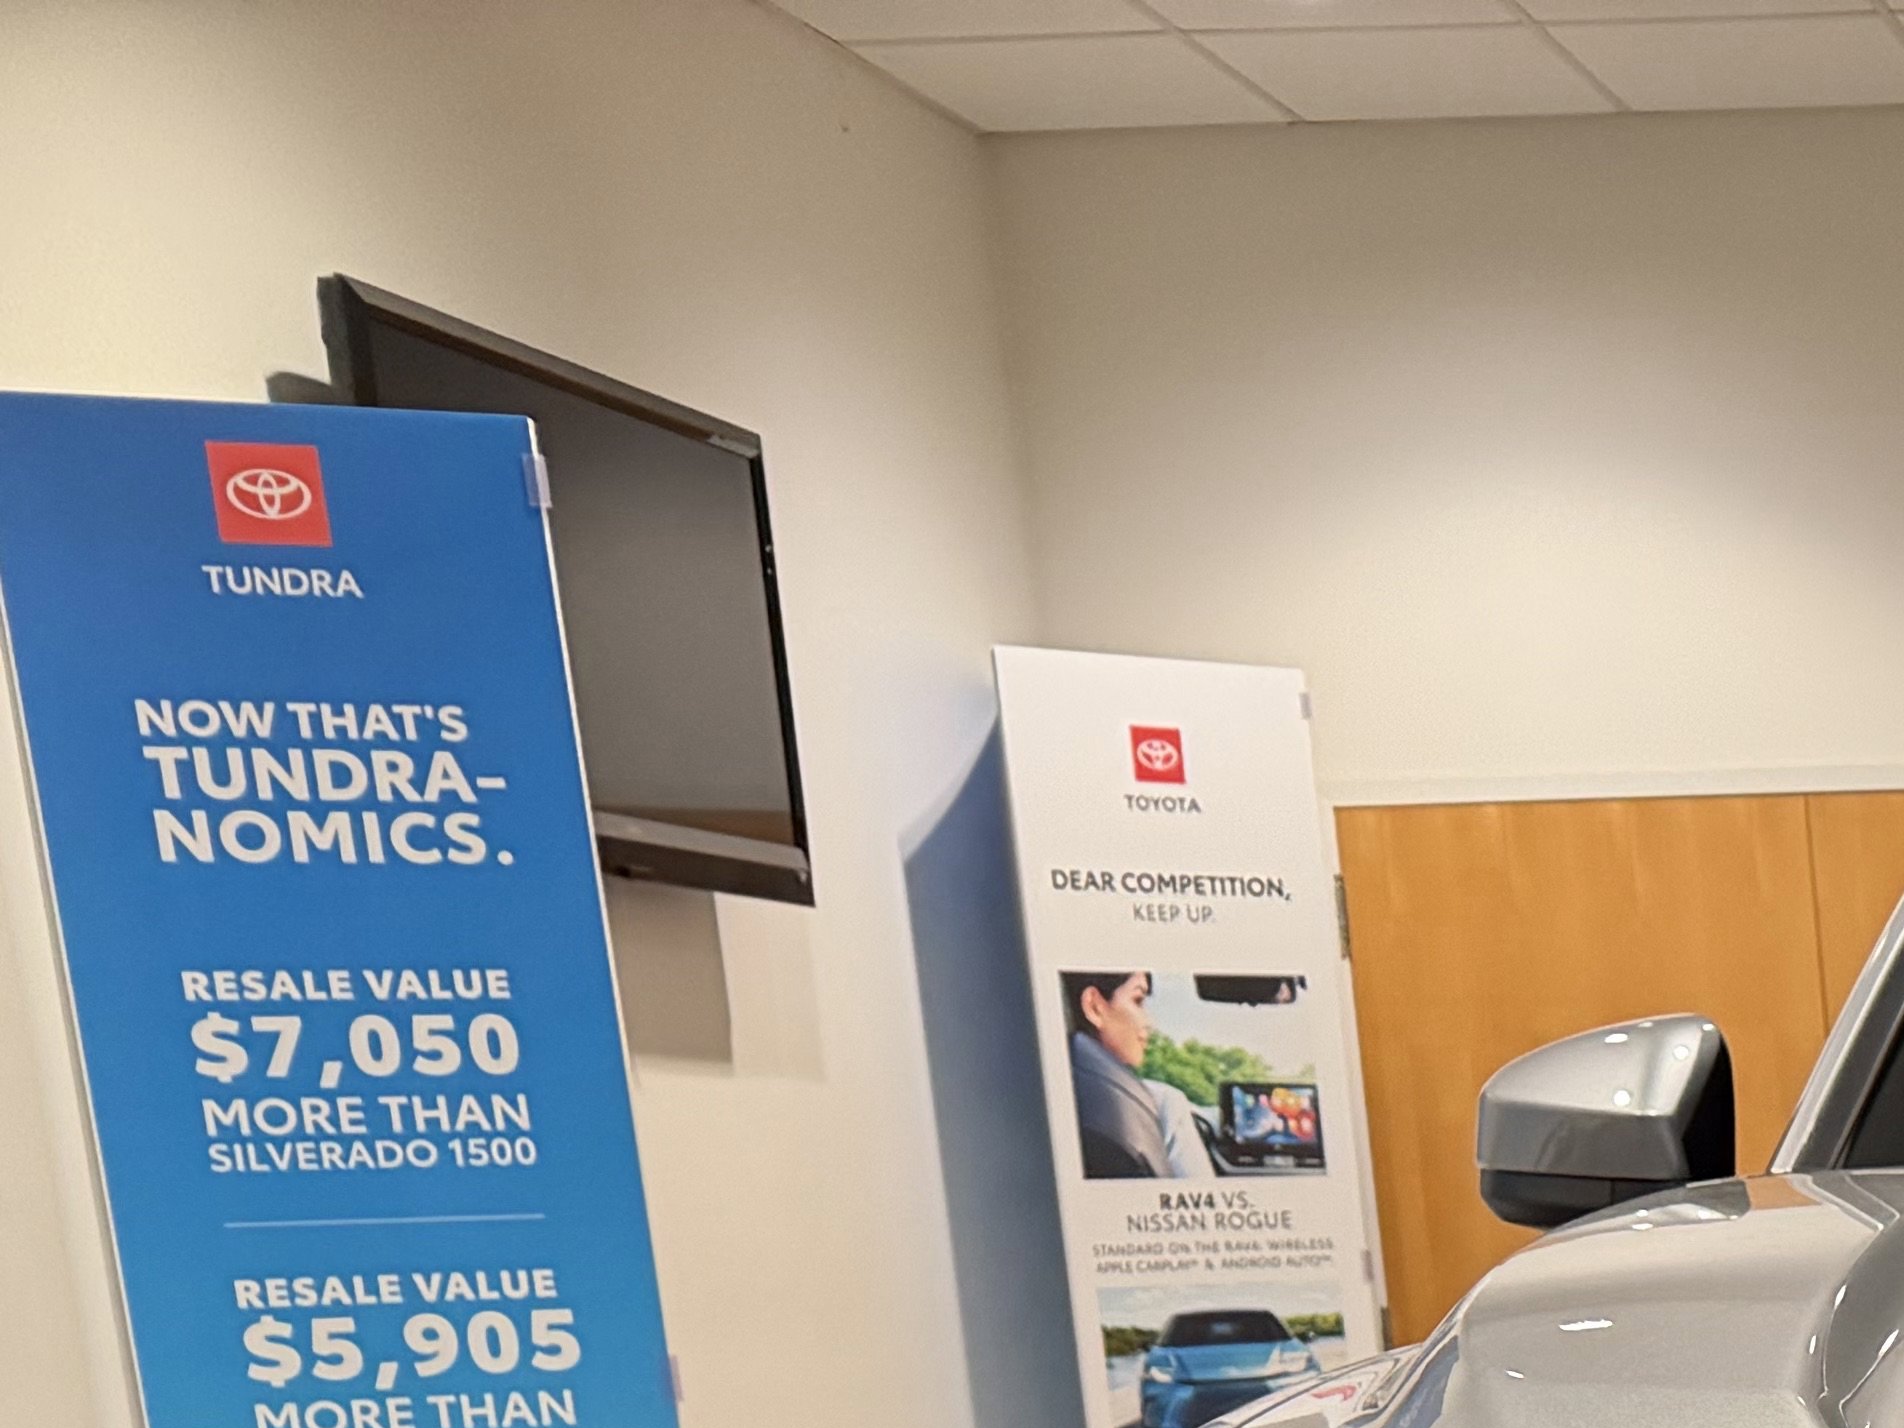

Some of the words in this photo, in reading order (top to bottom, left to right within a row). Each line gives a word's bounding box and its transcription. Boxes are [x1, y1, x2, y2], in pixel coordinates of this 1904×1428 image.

[201, 565, 364, 598] TUNDRA
[134, 699, 274, 740] NOW
[287, 703, 468, 742] THAT'S
[1124, 793, 1201, 814] TOYOTA
[153, 809, 515, 866] NOMICS.
[1051, 869, 1117, 893] DEAR
[1121, 872, 1292, 901] COMPETITION,
[1133, 904, 1180, 923] KEEP
[1187, 906, 1216, 925] UP.
[181, 971, 353, 1004] RESALE
[361, 969, 511, 1000] VALUE
[190, 1012, 520, 1089] $7,050
[201, 1097, 366, 1136] MORE
[379, 1094, 531, 1132] THAN
[208, 1139, 438, 1173] SILVERADO
[447, 1137, 538, 1168] 1500
[1158, 1192, 1215, 1210] RAV4
[1221, 1191, 1256, 1209] VS.
[1126, 1213, 1206, 1233] NISSAN
[1214, 1210, 1293, 1230] ROGUE
[1092, 1243, 1164, 1257] STANDARD
[1168, 1241, 1191, 1254] ON
[1194, 1240, 1220, 1253] THE
[1266, 1238, 1334, 1251] WIRELESS
[1096, 1260, 1133, 1275] APPLE
[1220, 1255, 1282, 1270] ANDROID
[233, 1273, 403, 1310] RESALE
[410, 1268, 558, 1302] VALUE
[242, 1308, 583, 1389] $5,905
